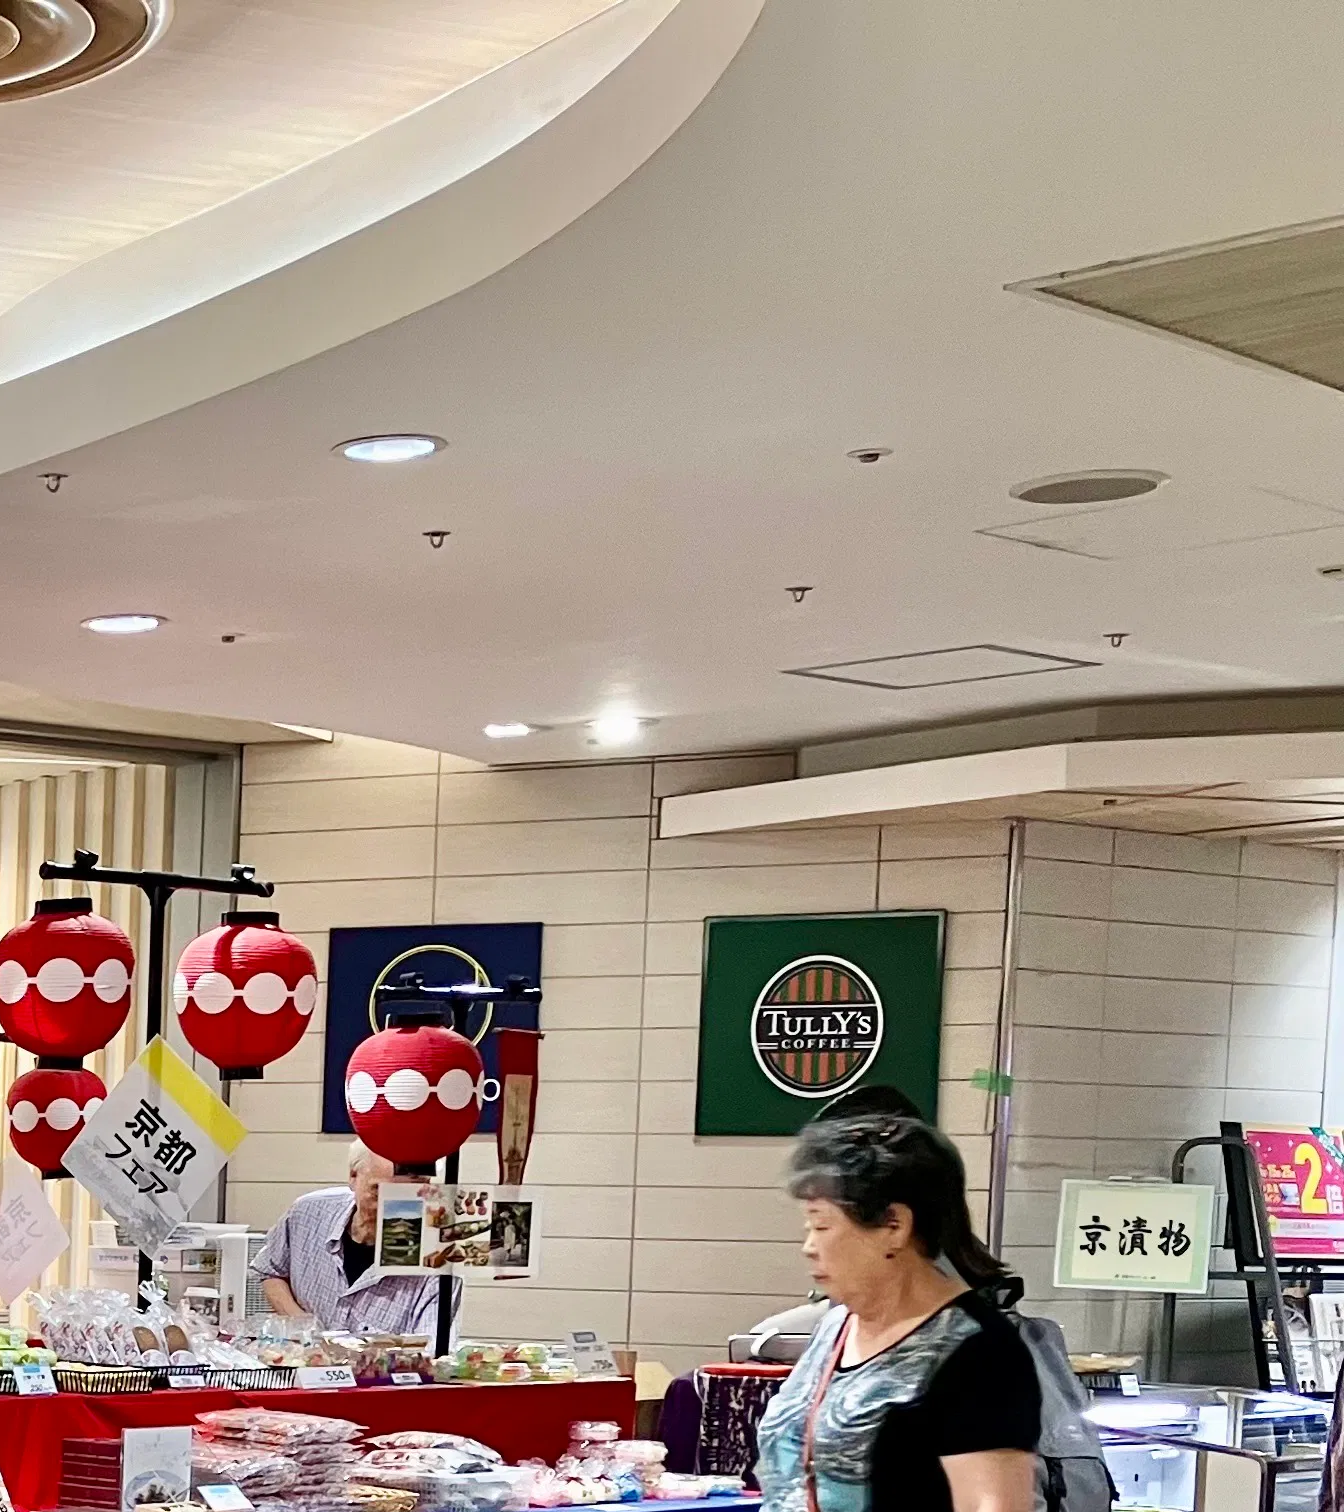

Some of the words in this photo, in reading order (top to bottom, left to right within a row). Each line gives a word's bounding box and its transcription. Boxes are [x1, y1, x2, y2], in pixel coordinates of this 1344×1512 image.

[763, 1010, 873, 1037] TULLY'S
[781, 1038, 852, 1050] COFFEE
[124, 1098, 197, 1175] 京都
[104, 1132, 169, 1194] フェア
[1078, 1215, 1192, 1257] 京漬物
